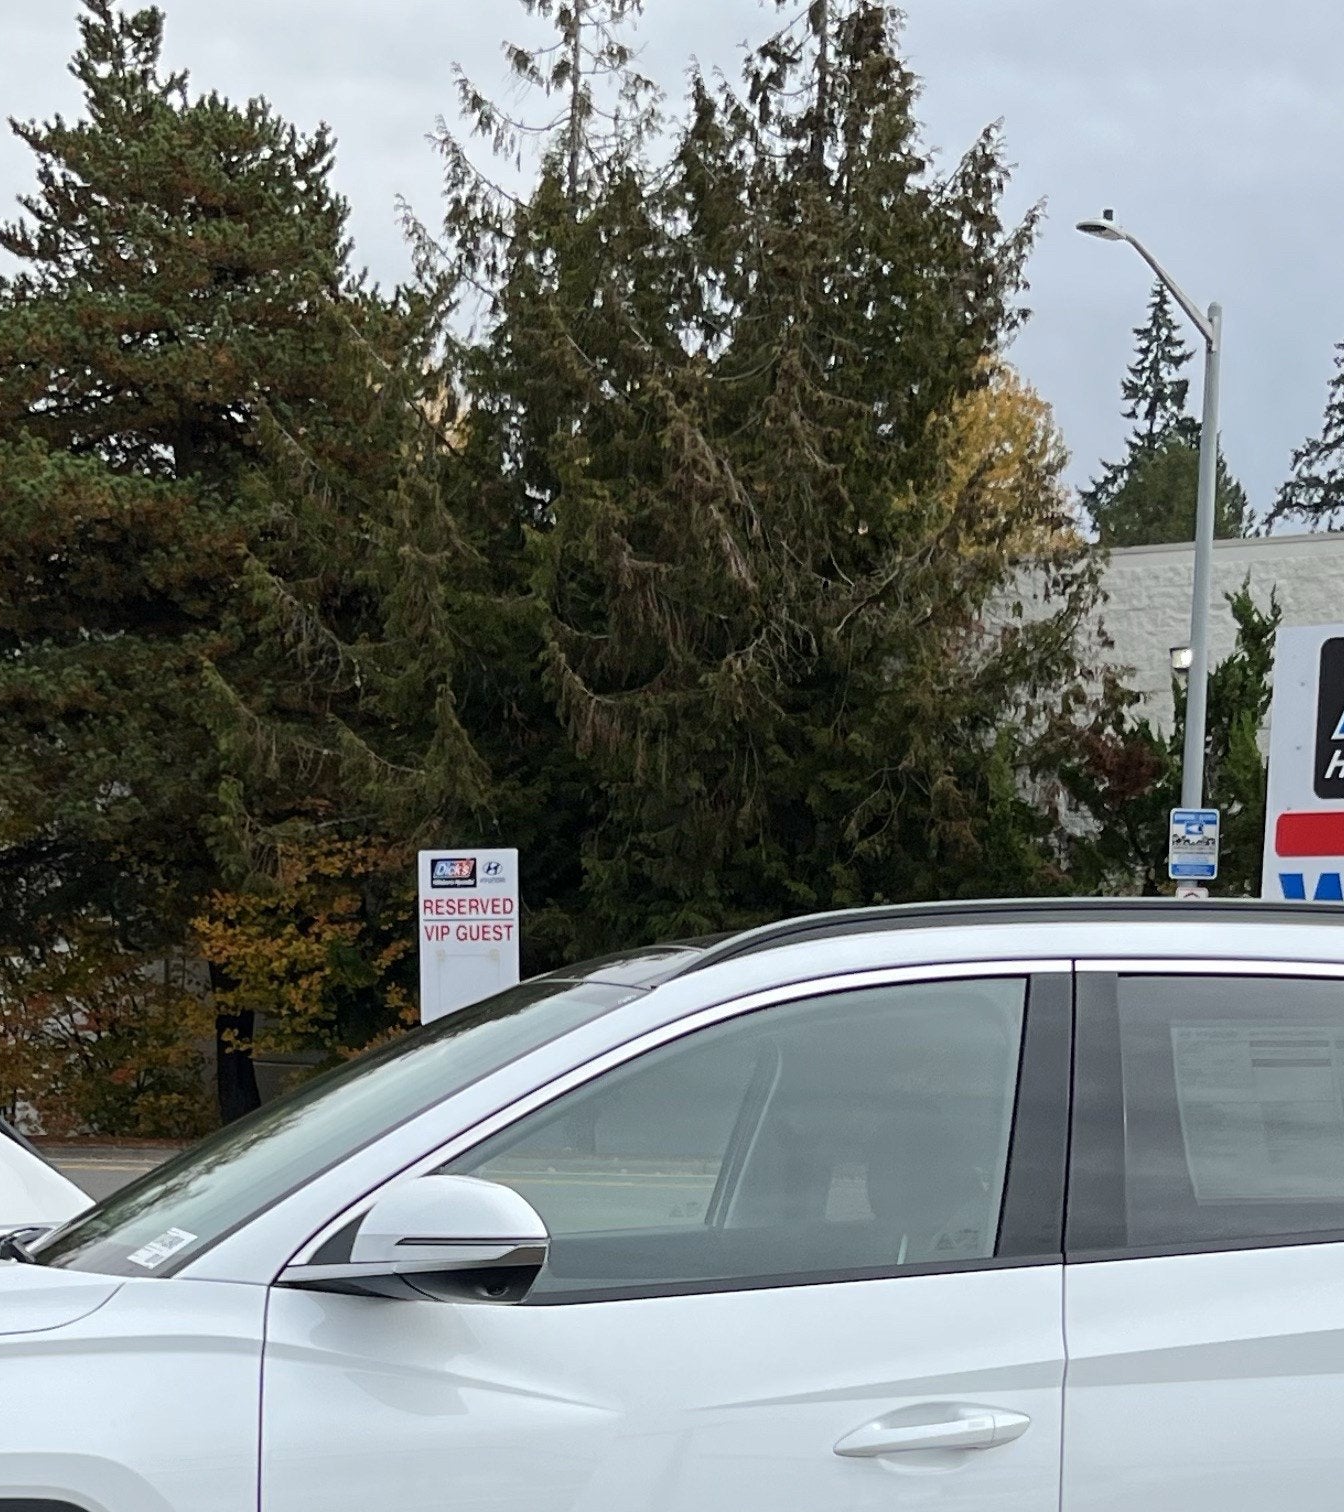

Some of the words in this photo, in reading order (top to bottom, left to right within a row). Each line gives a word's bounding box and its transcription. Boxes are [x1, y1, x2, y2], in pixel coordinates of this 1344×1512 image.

[423, 897, 514, 916] RESERVED
[424, 925, 450, 942] VIP
[456, 924, 514, 942] GUEST
